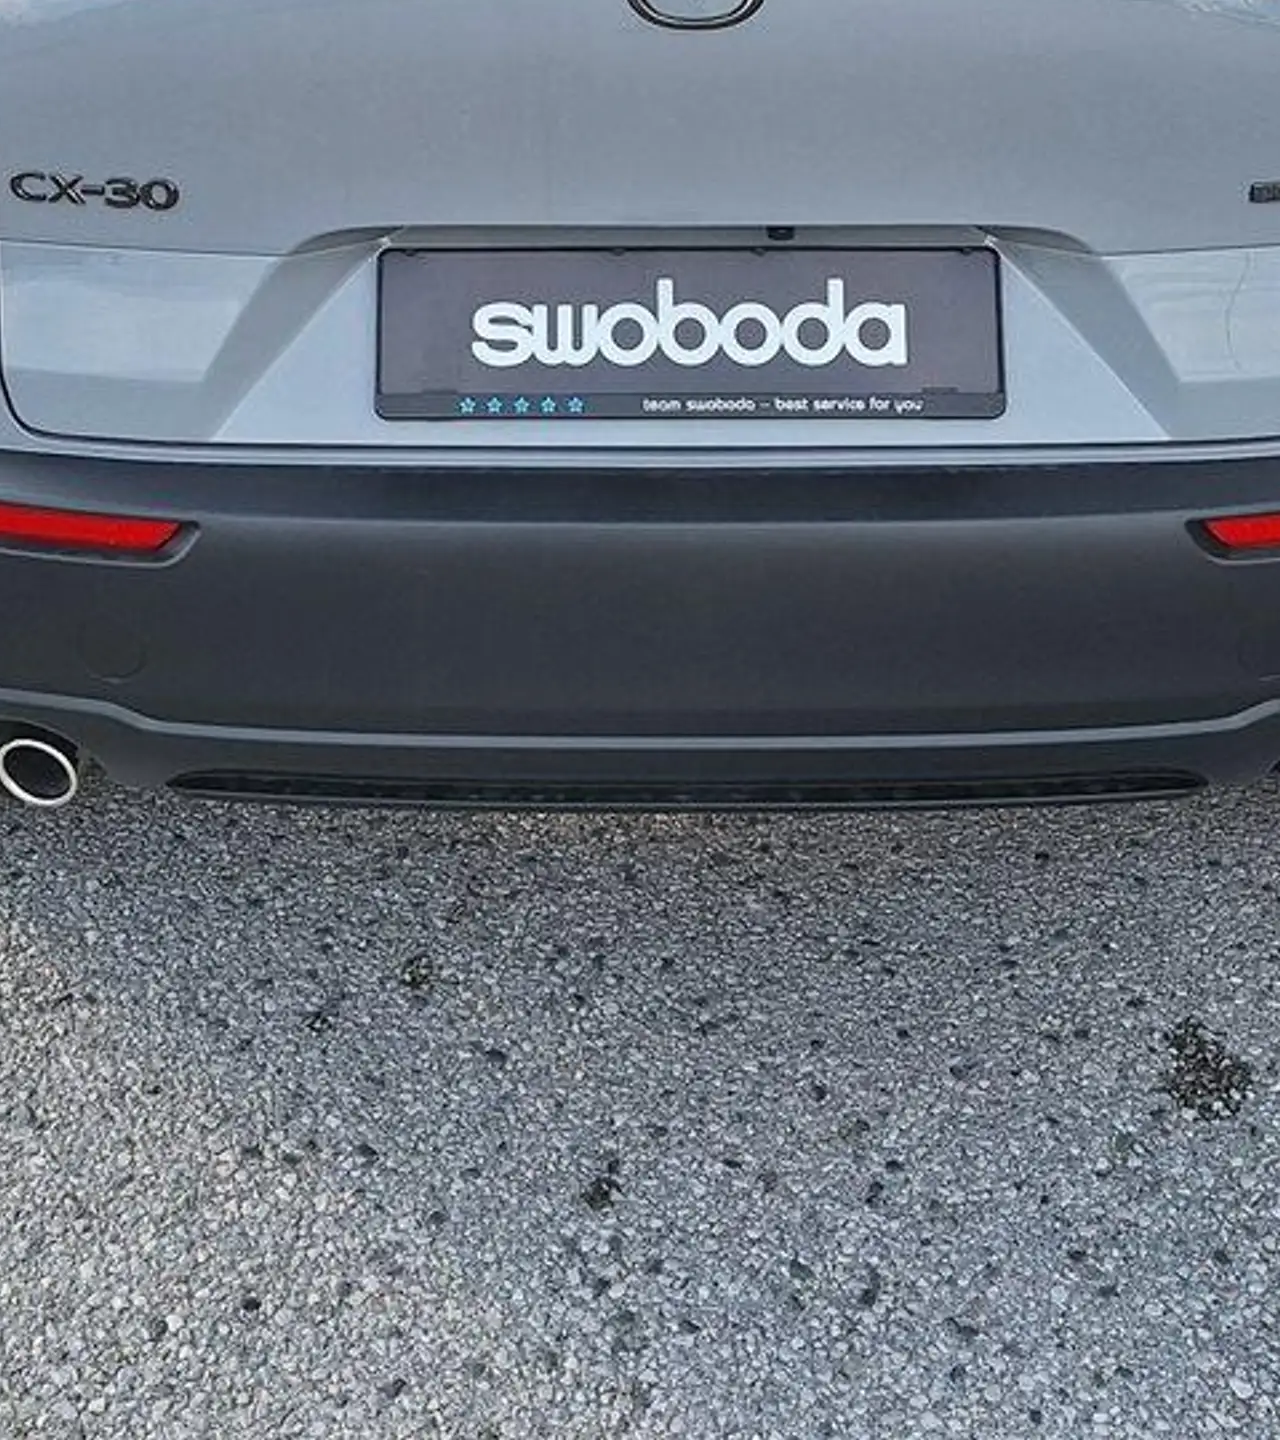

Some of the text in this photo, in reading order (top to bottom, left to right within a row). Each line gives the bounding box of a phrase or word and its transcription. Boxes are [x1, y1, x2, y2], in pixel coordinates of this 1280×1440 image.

[10, 171, 180, 211] CX-30
[471, 277, 908, 367] swoboda
[642, 397, 682, 411] team
[685, 397, 756, 412] swoboda
[774, 396, 810, 411] best
[813, 396, 866, 411] service
[869, 396, 891, 411] for
[893, 399, 925, 415] you
